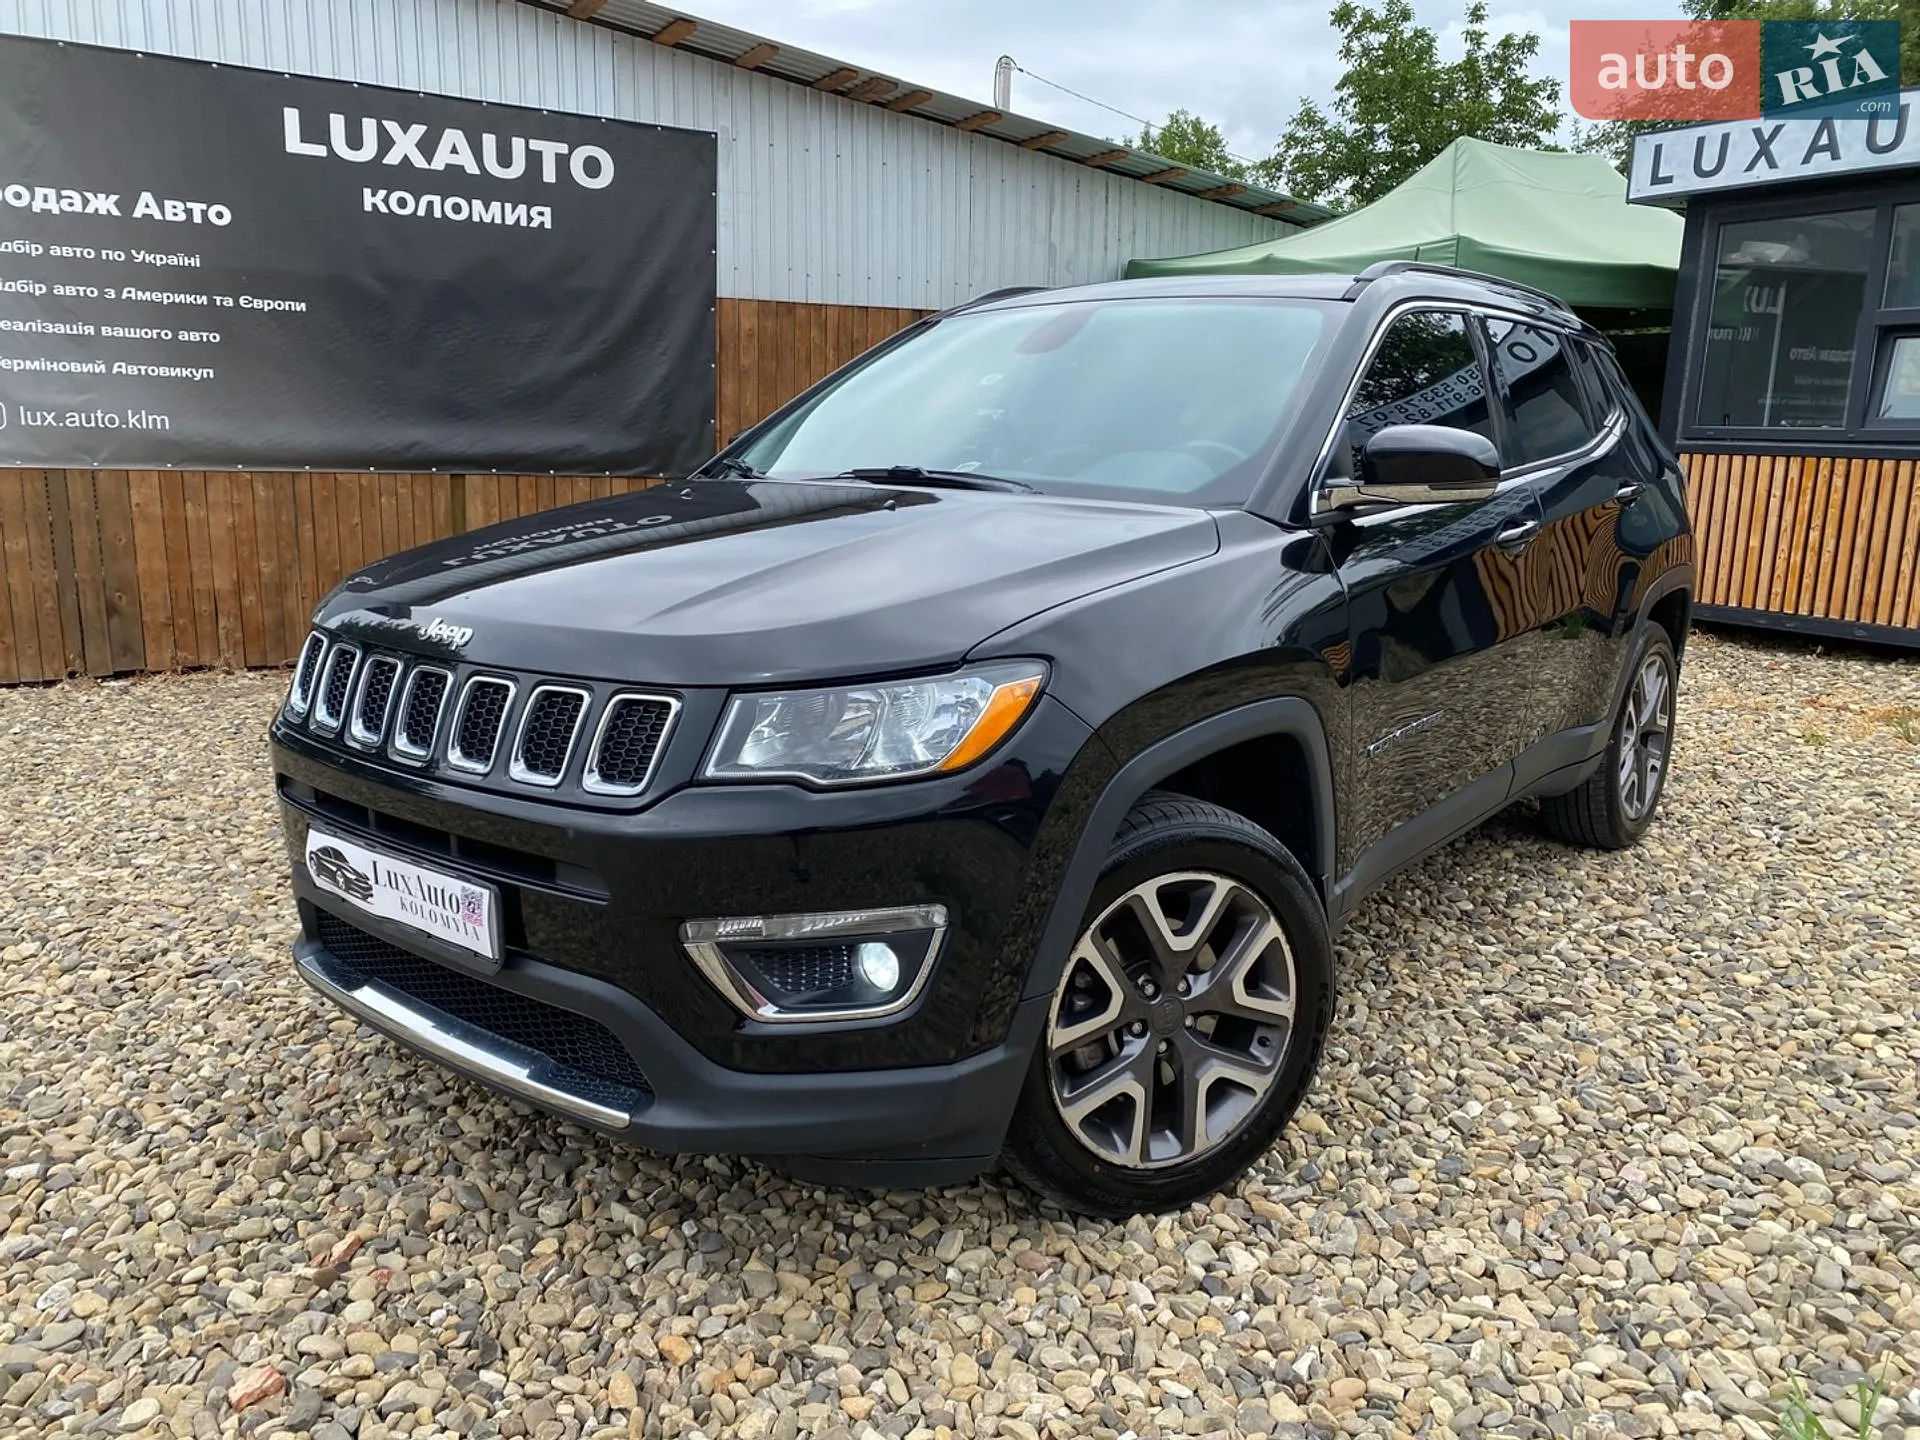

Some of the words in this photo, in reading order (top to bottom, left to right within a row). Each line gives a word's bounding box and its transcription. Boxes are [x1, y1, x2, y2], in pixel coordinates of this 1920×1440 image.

[283, 107, 615, 190] LUXAUTO
[1649, 103, 1911, 187] LUXAU
[0, 184, 122, 217] одаж
[132, 191, 232, 226] Авто
[363, 187, 553, 230] КОЛОМИЯ
[49, 245, 96, 259] авто
[101, 249, 126, 261] по
[130, 249, 200, 268] Україні
[52, 284, 98, 298] авто
[103, 288, 116, 299] з
[121, 287, 208, 305] Америки
[213, 296, 234, 307] та
[239, 295, 306, 312] Європи
[0, 320, 94, 335] еалізація
[101, 326, 172, 340] вашого
[177, 330, 221, 343] авто
[0, 356, 106, 373] ерміновий
[112, 362, 214, 381] Автовикуп
[19, 405, 170, 430] lux.auto.klm
[417, 617, 475, 651] Jeep
[373, 860, 461, 915] LuxAuto
